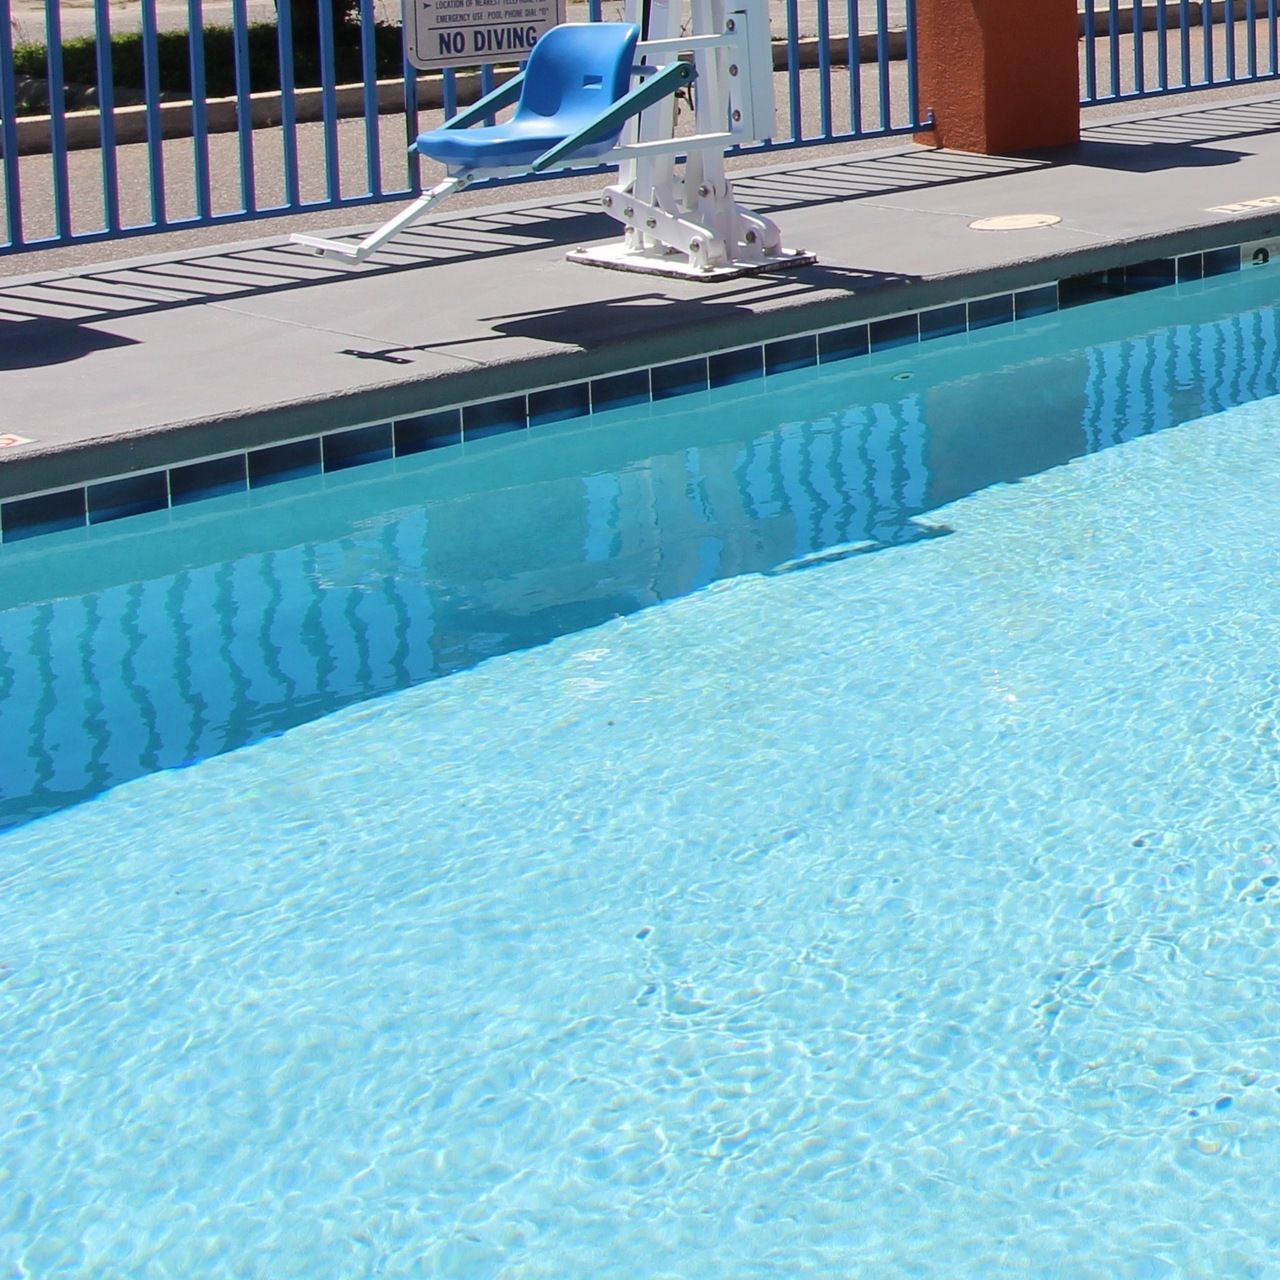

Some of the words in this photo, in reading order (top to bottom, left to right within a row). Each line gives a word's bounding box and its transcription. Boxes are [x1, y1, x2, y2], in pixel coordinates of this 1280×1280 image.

[436, 0, 464, 9] LOCATION
[436, 13, 470, 23] EMERGENCY
[487, 10, 503, 20] POOL
[504, 9, 523, 18] PHONE
[525, 8, 538, 17] DIAL
[438, 31, 466, 54] NO
[474, 26, 538, 51] DIVING
